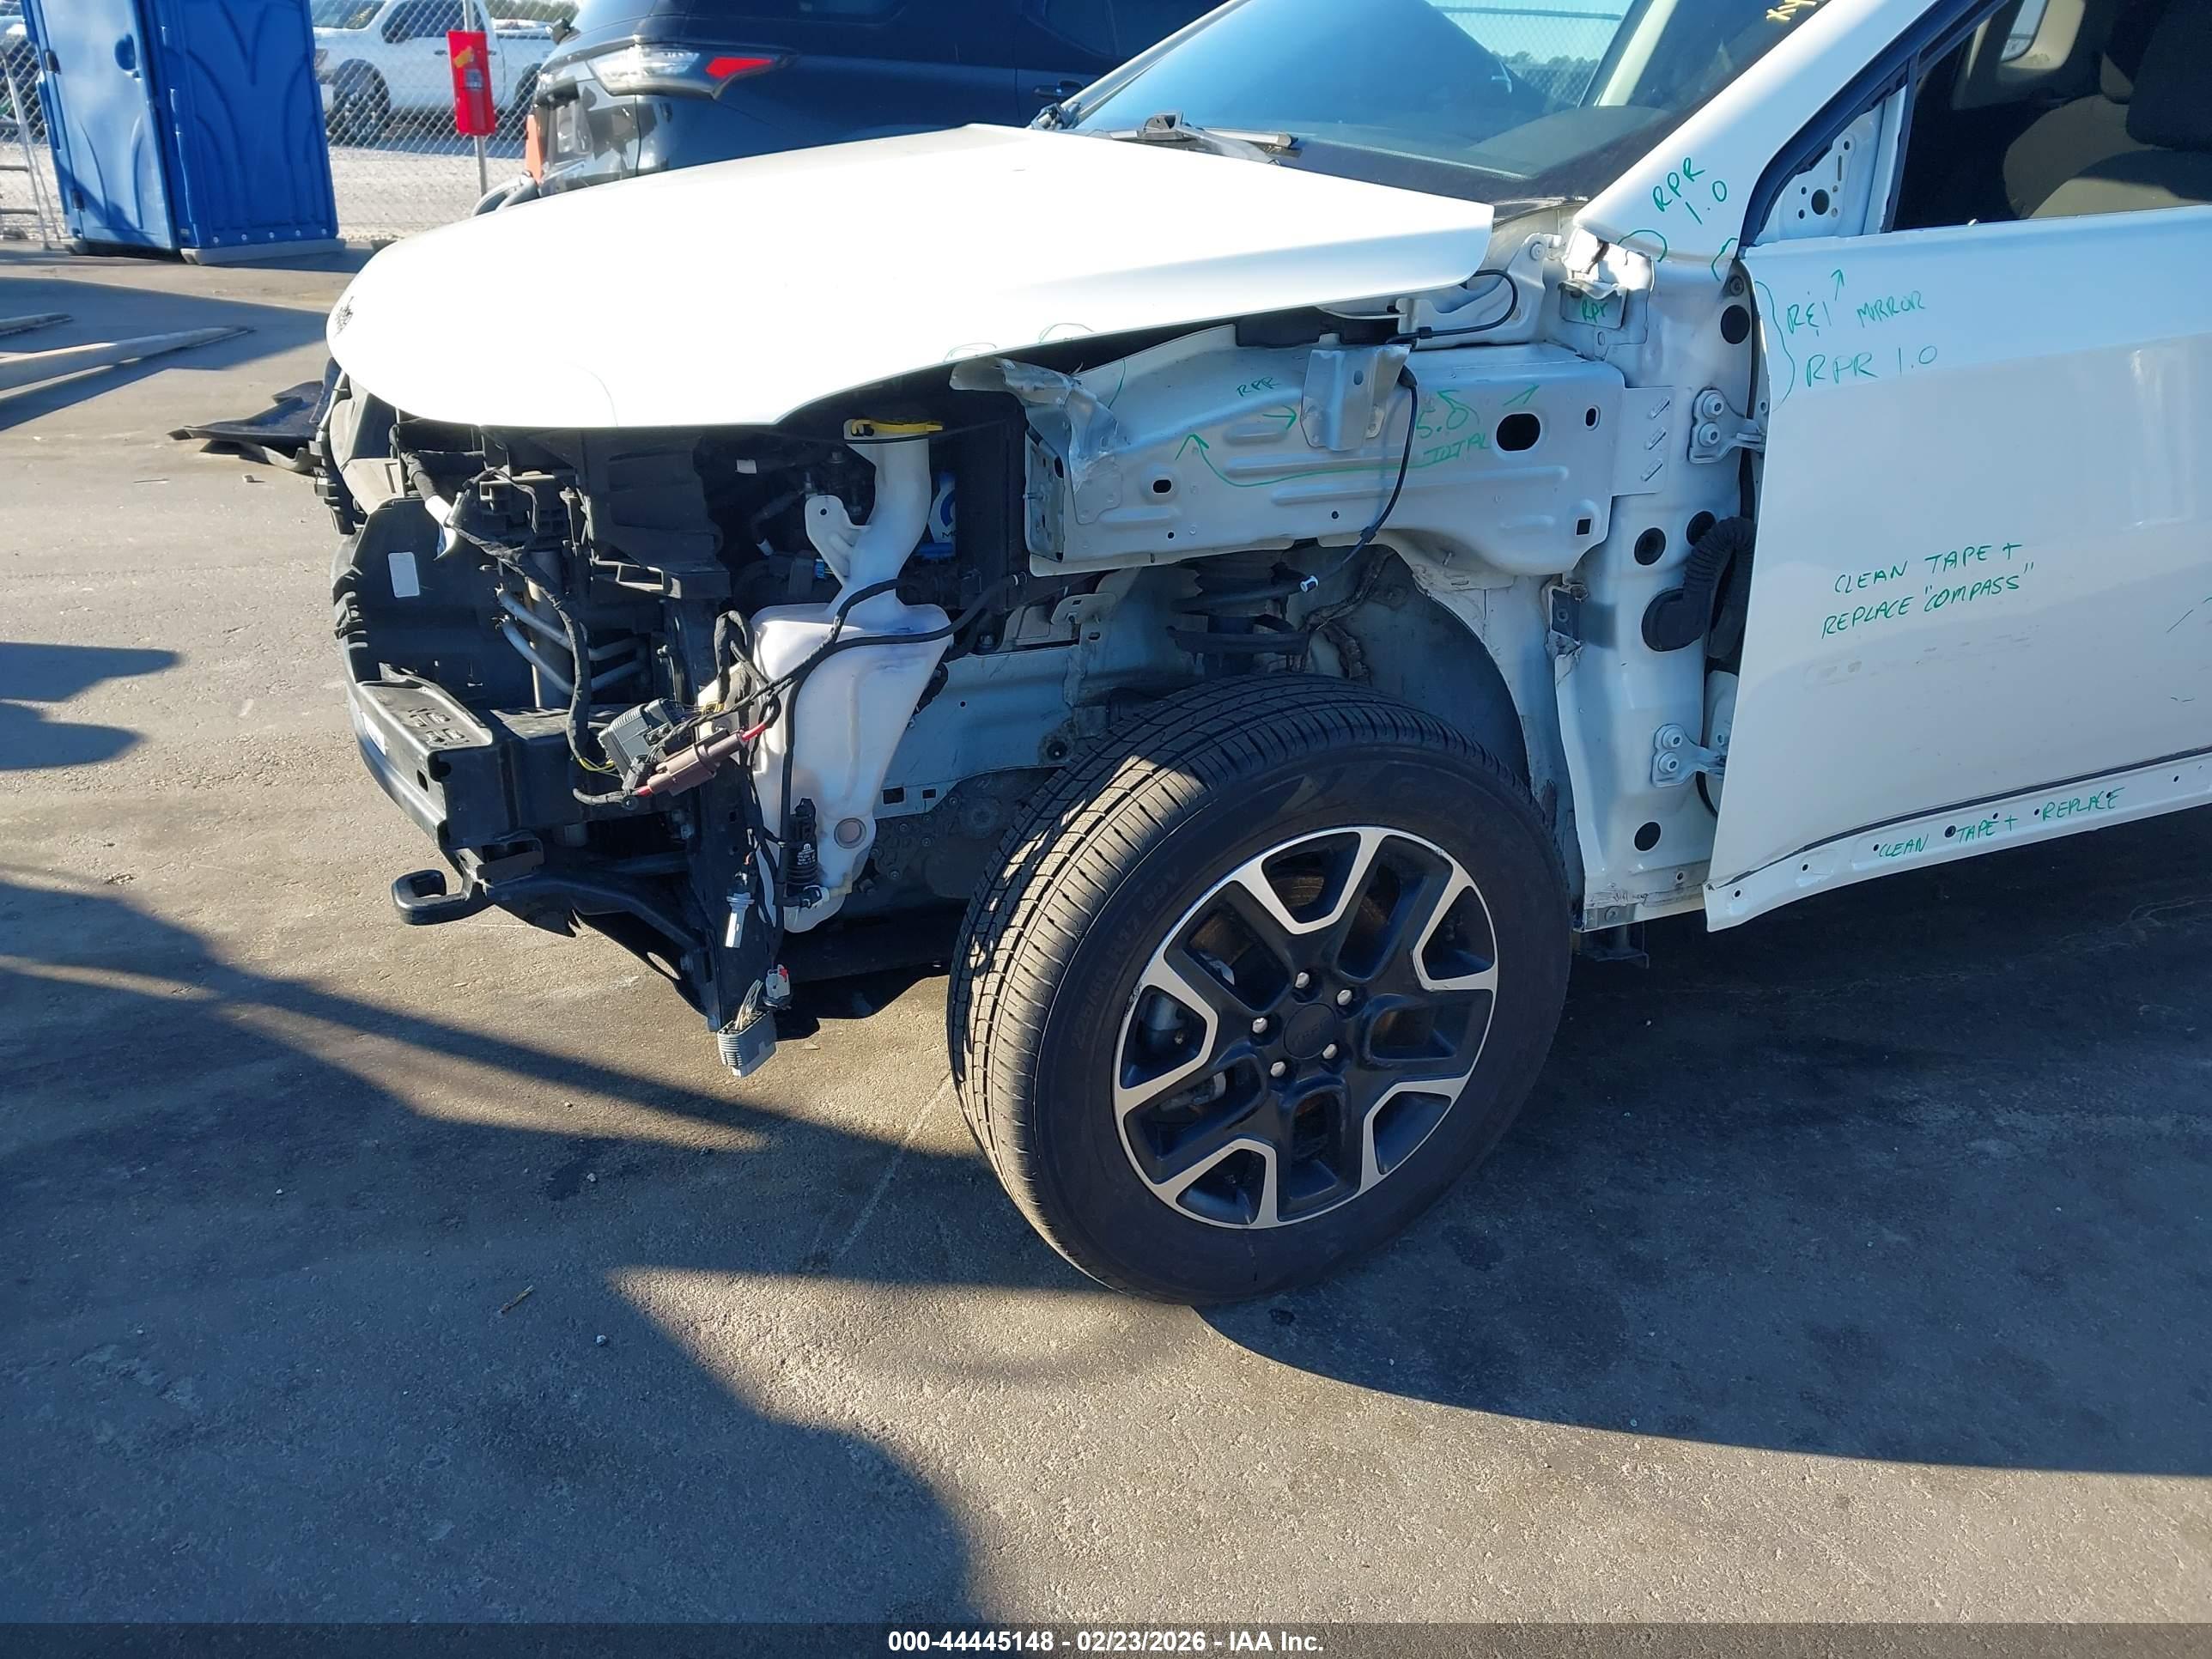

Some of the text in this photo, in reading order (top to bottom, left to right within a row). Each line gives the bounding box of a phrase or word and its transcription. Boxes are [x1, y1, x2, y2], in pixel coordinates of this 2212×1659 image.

[1653, 157, 1705, 212] RPR
[1685, 180, 1728, 225] 1.0
[1856, 290, 1926, 328] MIRROR
[1237, 376, 1282, 398] RPR
[1807, 346, 1937, 387] RPR 1.0
[1834, 560, 1908, 593] CLEAN
[1924, 544, 1992, 574] TAPE
[1821, 596, 1915, 640] REPLACE
[1879, 834, 1929, 857] CLEAN
[1957, 818, 1999, 843] TAPE
[2041, 787, 2124, 821] REPLACE
